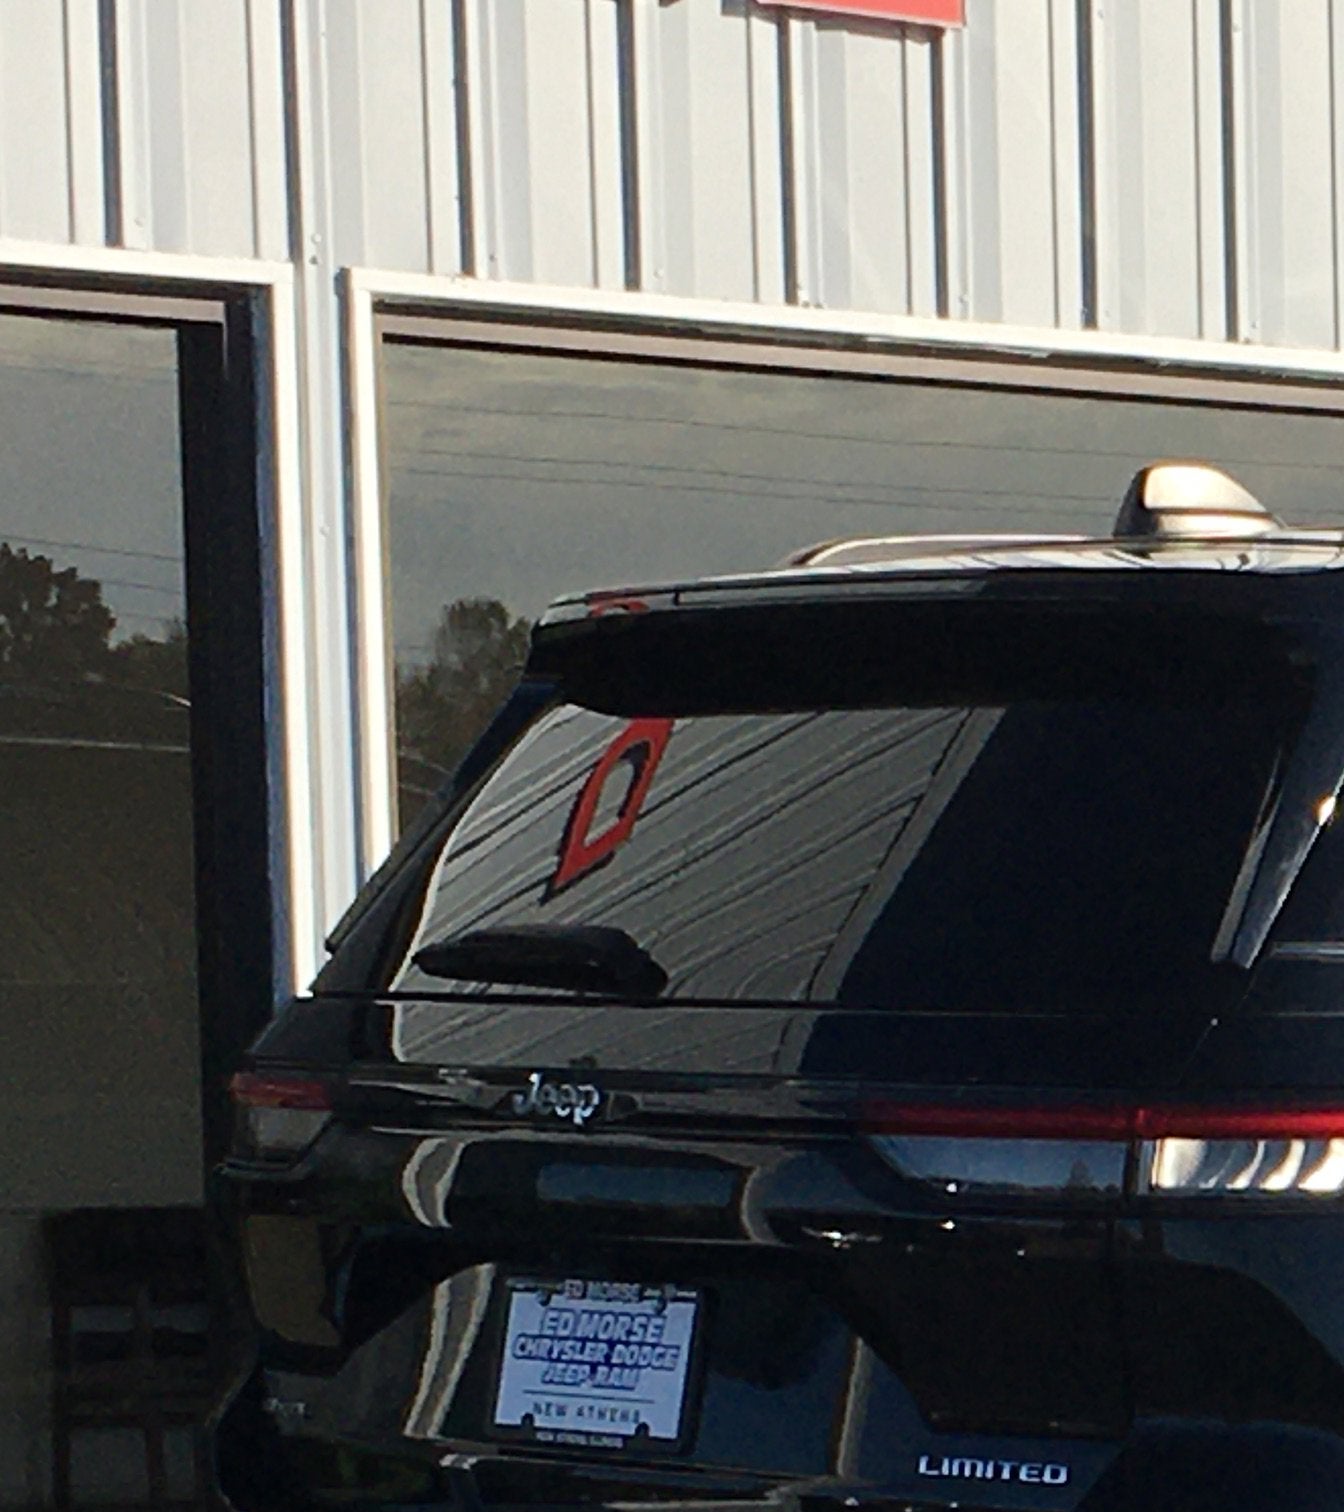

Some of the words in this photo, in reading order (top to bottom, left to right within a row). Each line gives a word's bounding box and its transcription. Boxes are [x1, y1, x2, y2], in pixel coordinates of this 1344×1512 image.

[513, 1072, 599, 1126] Jeep
[541, 1308, 576, 1336] ED
[577, 1310, 667, 1343] MORSE
[513, 1333, 610, 1366] CHRYSLER
[611, 1342, 681, 1371] DODGE
[532, 1402, 568, 1417] NEW
[918, 1455, 1068, 1484] LIMITED
